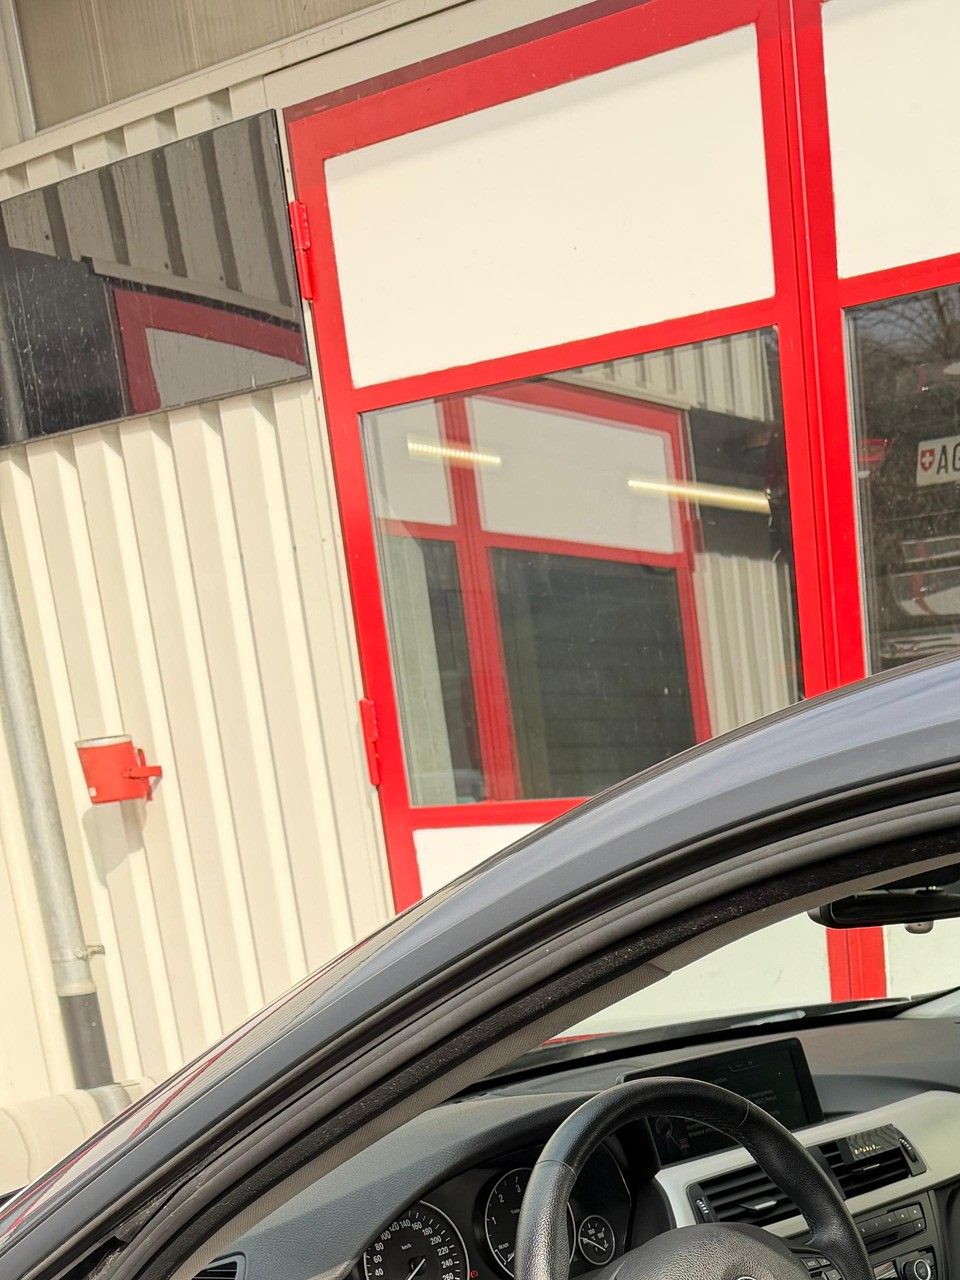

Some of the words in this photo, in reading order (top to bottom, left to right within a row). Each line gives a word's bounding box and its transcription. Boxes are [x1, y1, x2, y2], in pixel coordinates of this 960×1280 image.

[515, 1184, 521, 1193] 3
[498, 1194, 505, 1203] 2
[388, 1221, 400, 1232] 120
[399, 1219, 411, 1229] 140
[380, 1230, 391, 1241] 100
[430, 1235, 442, 1246] 200
[374, 1242, 385, 1252] 80
[437, 1246, 449, 1256] 220
[373, 1254, 382, 1264] 60
[441, 1258, 453, 1269] 240
[375, 1268, 384, 1277] 40
